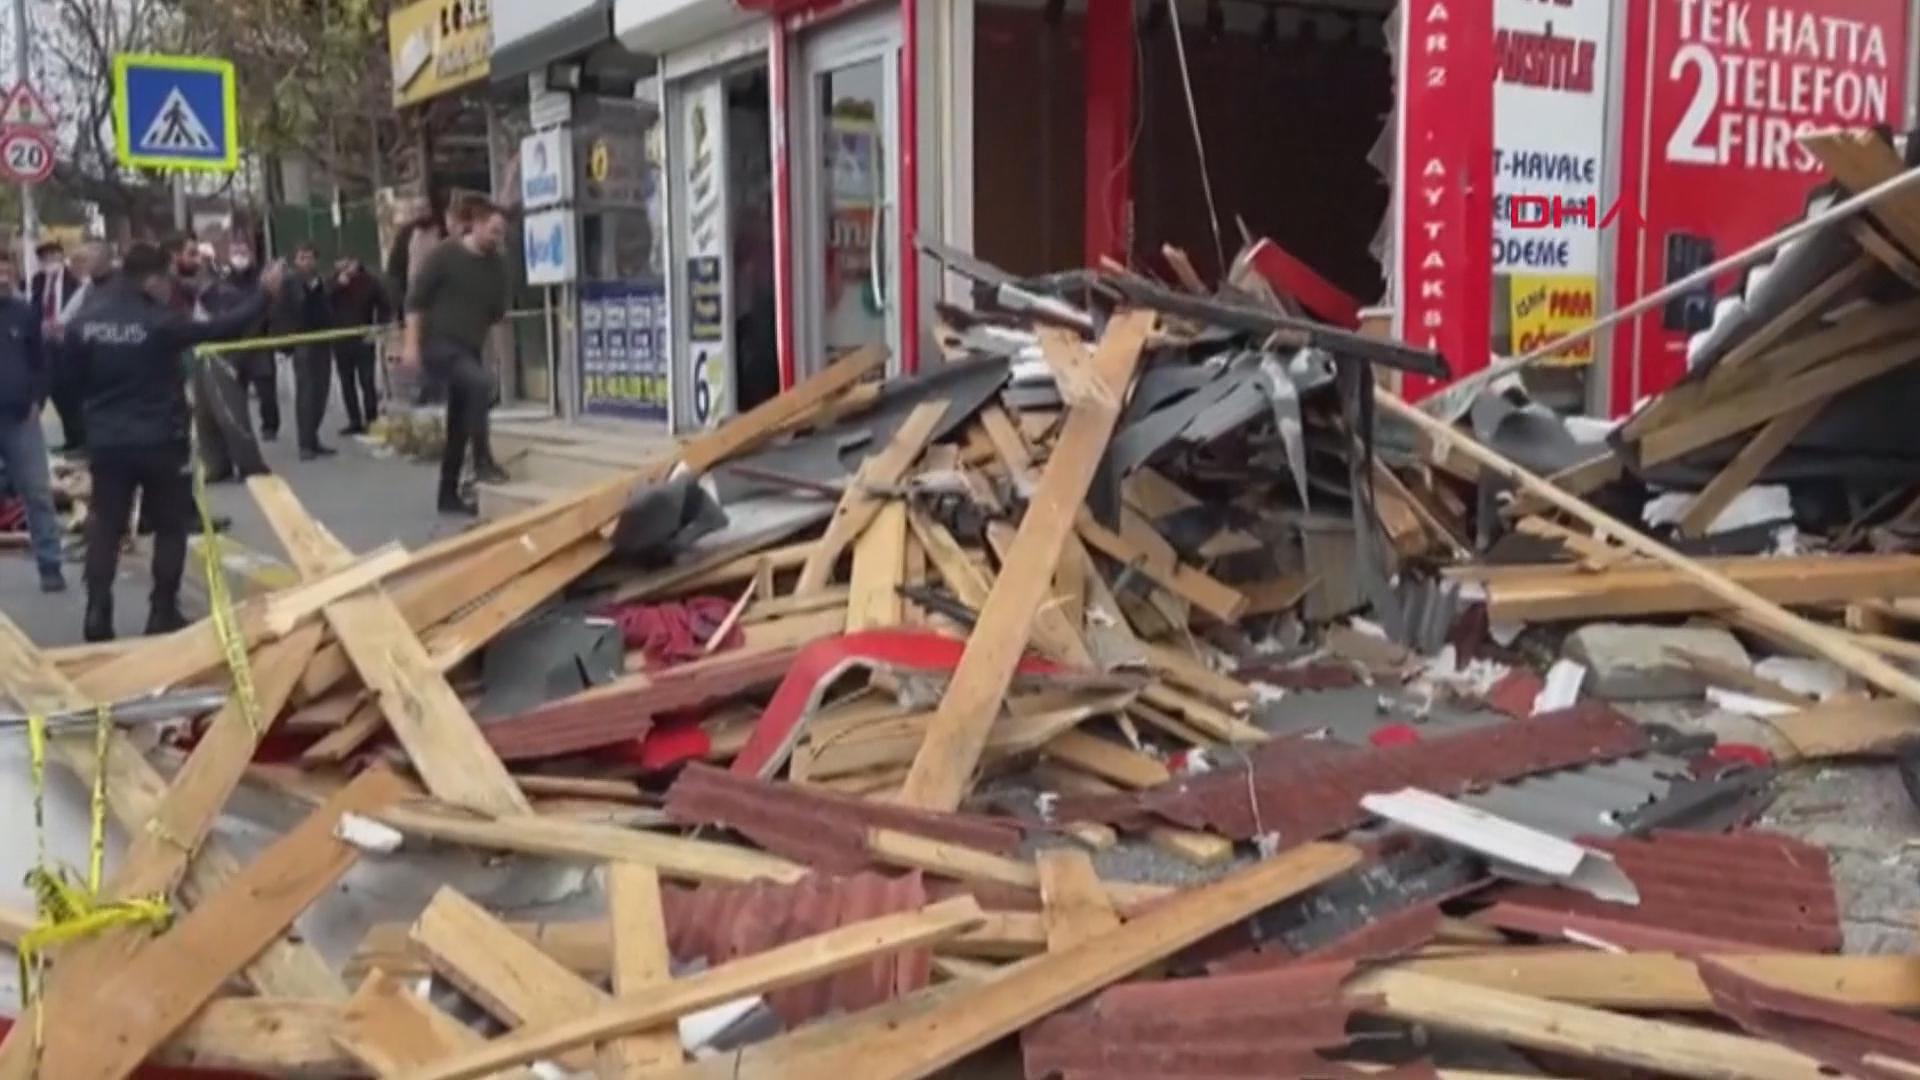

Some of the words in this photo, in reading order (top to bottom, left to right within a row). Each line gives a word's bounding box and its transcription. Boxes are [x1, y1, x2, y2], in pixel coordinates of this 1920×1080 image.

[1674, 0, 1752, 49] TEK
[1763, 6, 1888, 68] HATTA
[1665, 43, 1721, 164] 2
[1719, 54, 1889, 124] TELEFON
[10, 143, 43, 168] 20
[1716, 112, 1826, 173] FIRS
